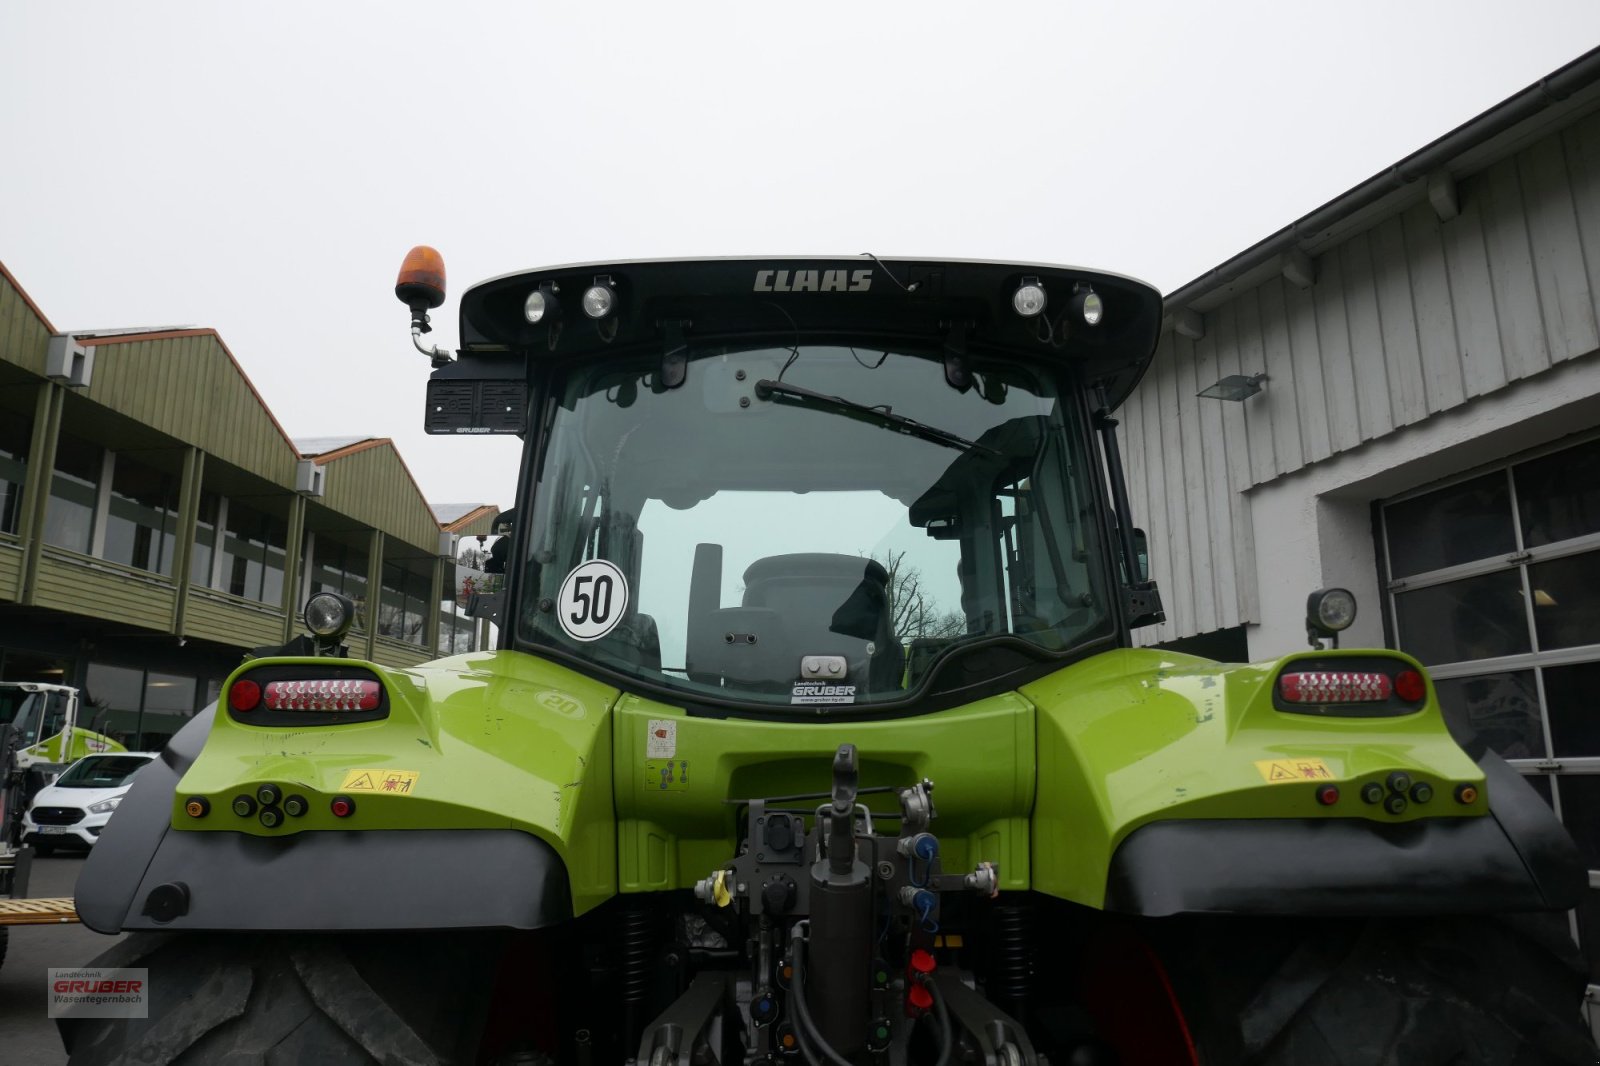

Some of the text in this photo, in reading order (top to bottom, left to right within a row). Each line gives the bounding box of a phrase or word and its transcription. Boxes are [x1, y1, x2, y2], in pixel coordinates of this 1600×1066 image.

[753, 270, 873, 292] CLAAS
[571, 575, 613, 625] 50
[792, 686, 856, 696] GRUBER
